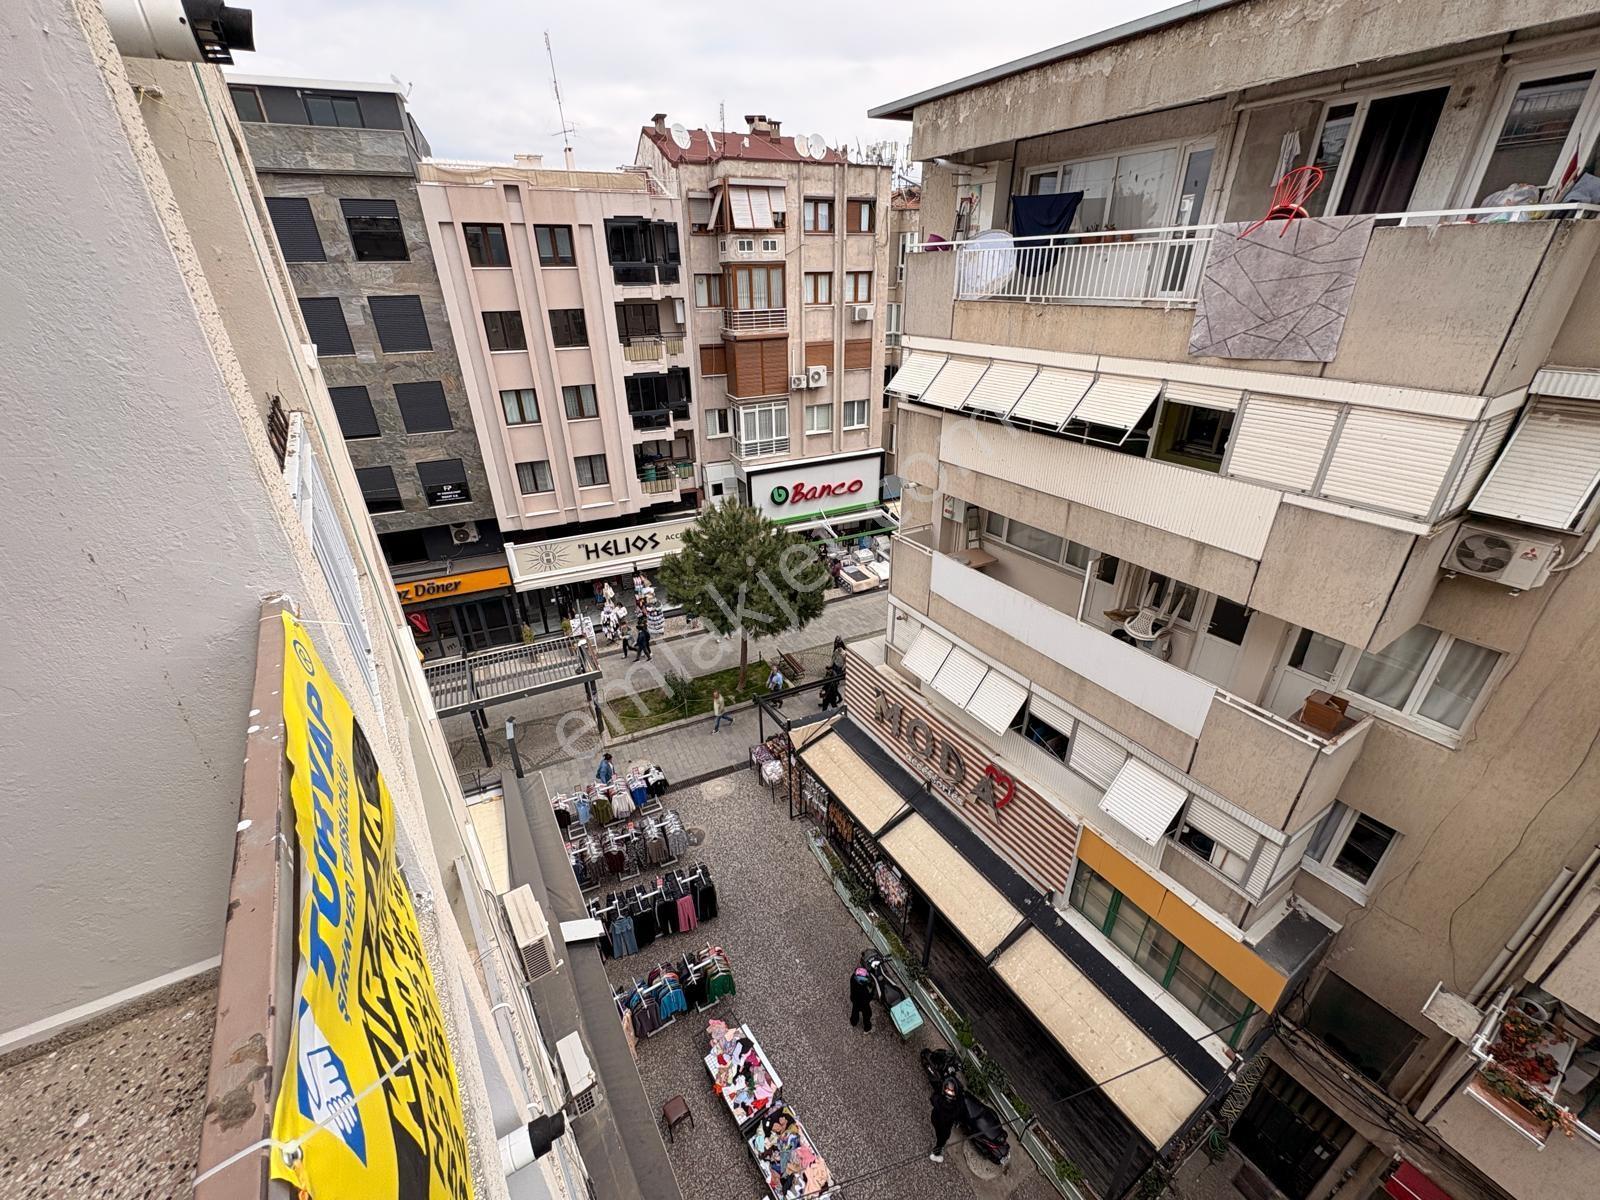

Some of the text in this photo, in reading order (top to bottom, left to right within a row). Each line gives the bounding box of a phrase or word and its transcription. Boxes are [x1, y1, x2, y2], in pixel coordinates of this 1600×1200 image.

[790, 479, 863, 504] Banco
[585, 533, 660, 560] HELIOS
[414, 581, 461, 597] Döner
[874, 687, 1000, 824] MODA
[307, 681, 341, 991] TURYAP
[395, 977, 446, 1190] Hakan
